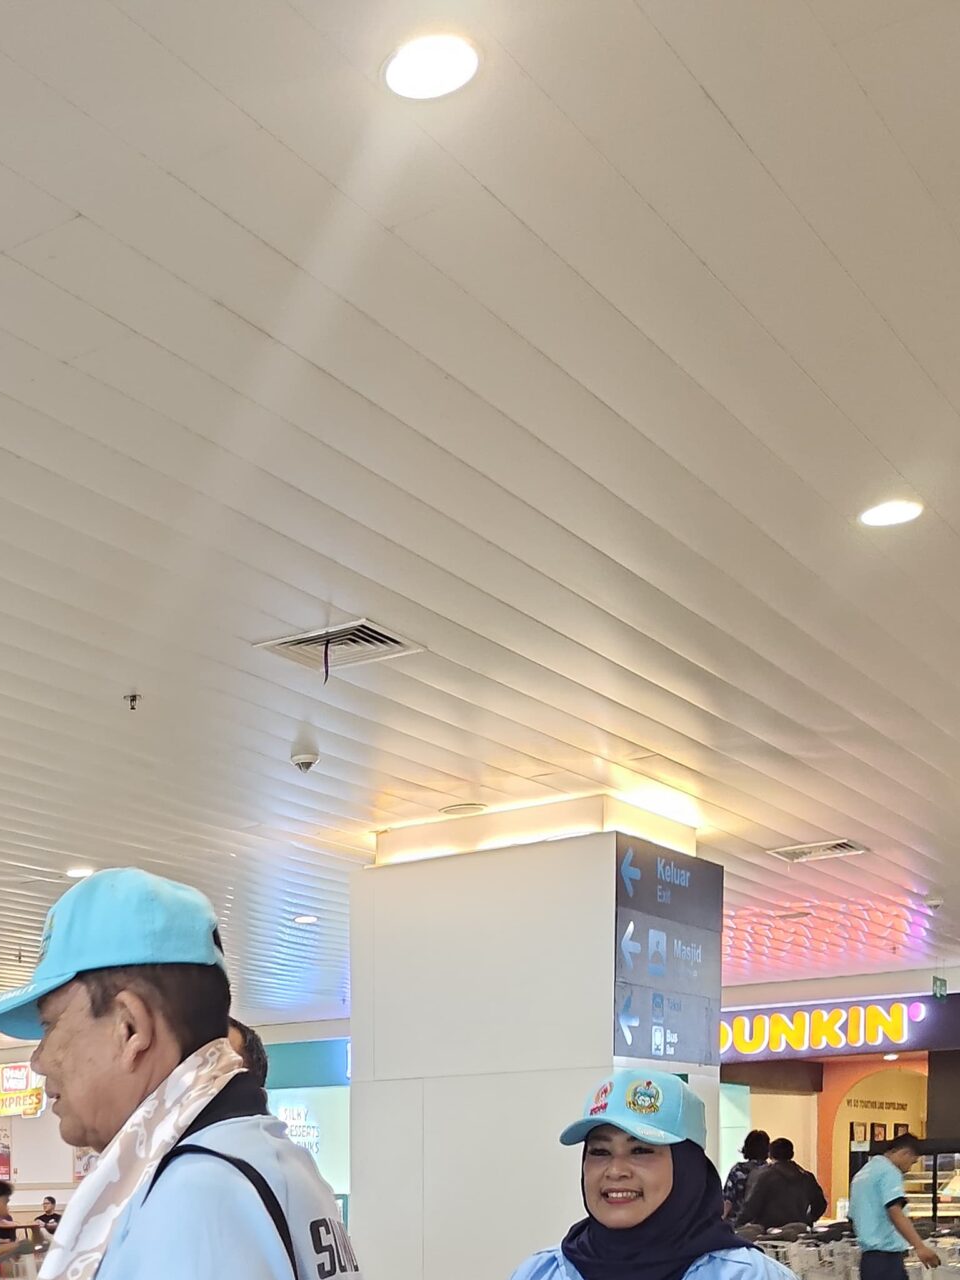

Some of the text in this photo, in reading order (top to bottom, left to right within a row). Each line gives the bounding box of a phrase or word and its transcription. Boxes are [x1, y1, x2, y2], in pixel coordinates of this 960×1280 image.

[656, 856, 690, 888] Keluar
[673, 938, 702, 966] Masjid
[665, 1029, 678, 1044] Bus
[283, 1107, 310, 1122] SILKY
[285, 1124, 320, 1139] ESSERTS
